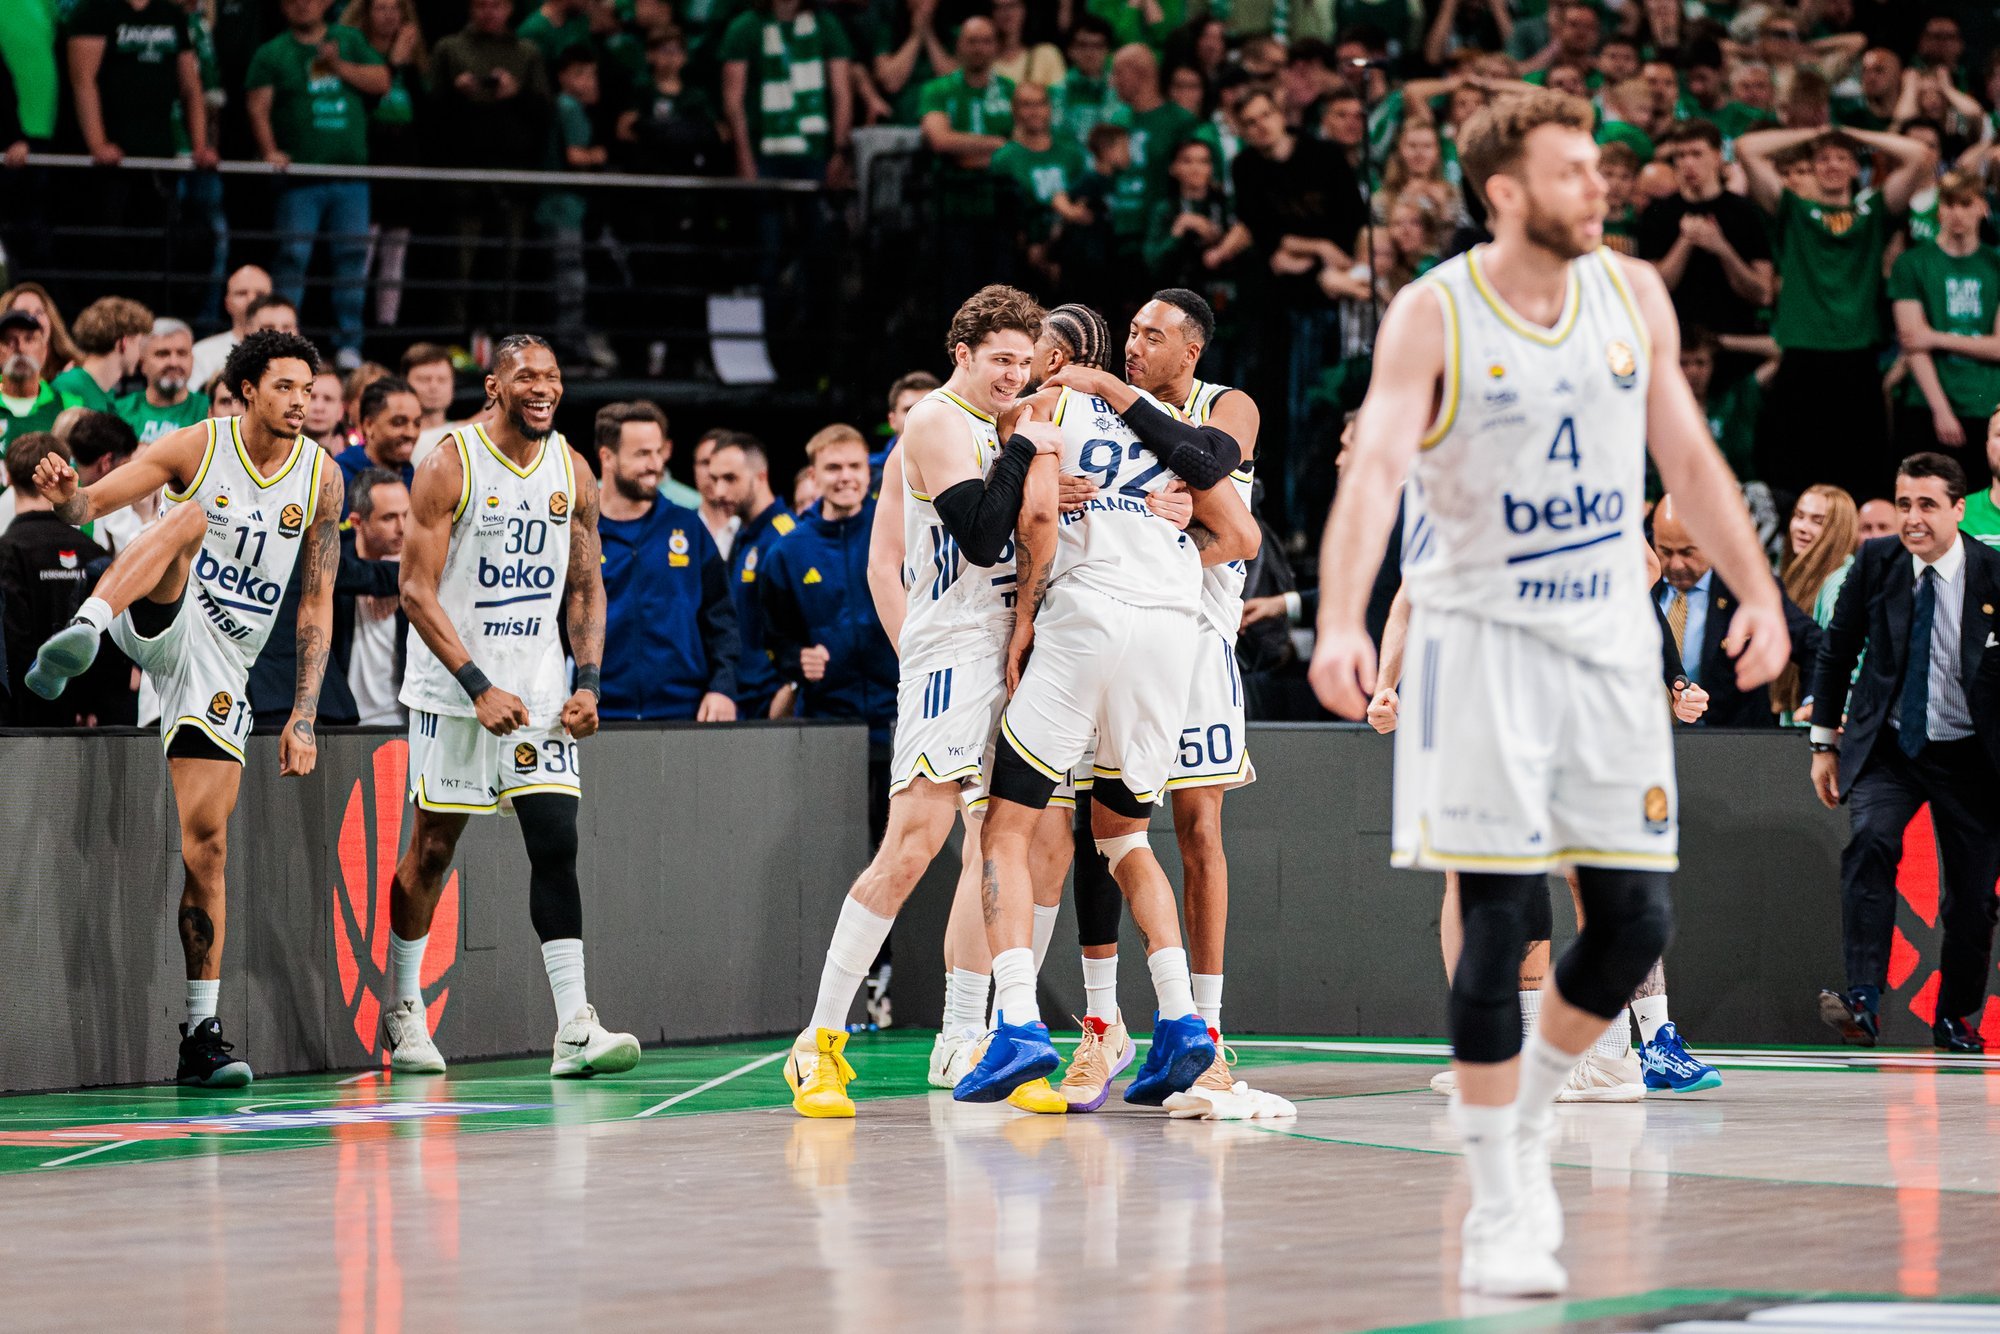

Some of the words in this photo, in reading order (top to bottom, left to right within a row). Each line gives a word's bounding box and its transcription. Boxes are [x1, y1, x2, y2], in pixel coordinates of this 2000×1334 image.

[1548, 416, 1581, 469] 4
[1079, 439, 1167, 499] 92
[206, 510, 229, 524] beko
[482, 514, 505, 523] beko
[1503, 485, 1624, 534] beko
[207, 528, 228, 541] AMS
[235, 526, 267, 567] 11
[505, 517, 547, 555] 30
[195, 547, 281, 605] beko
[478, 556, 556, 589] beko
[1518, 570, 1611, 600] misli
[197, 580, 254, 640] misli
[483, 616, 542, 637] misli
[947, 746, 965, 756] YKT
[1178, 723, 1233, 768] 50
[440, 778, 461, 788] YKT
